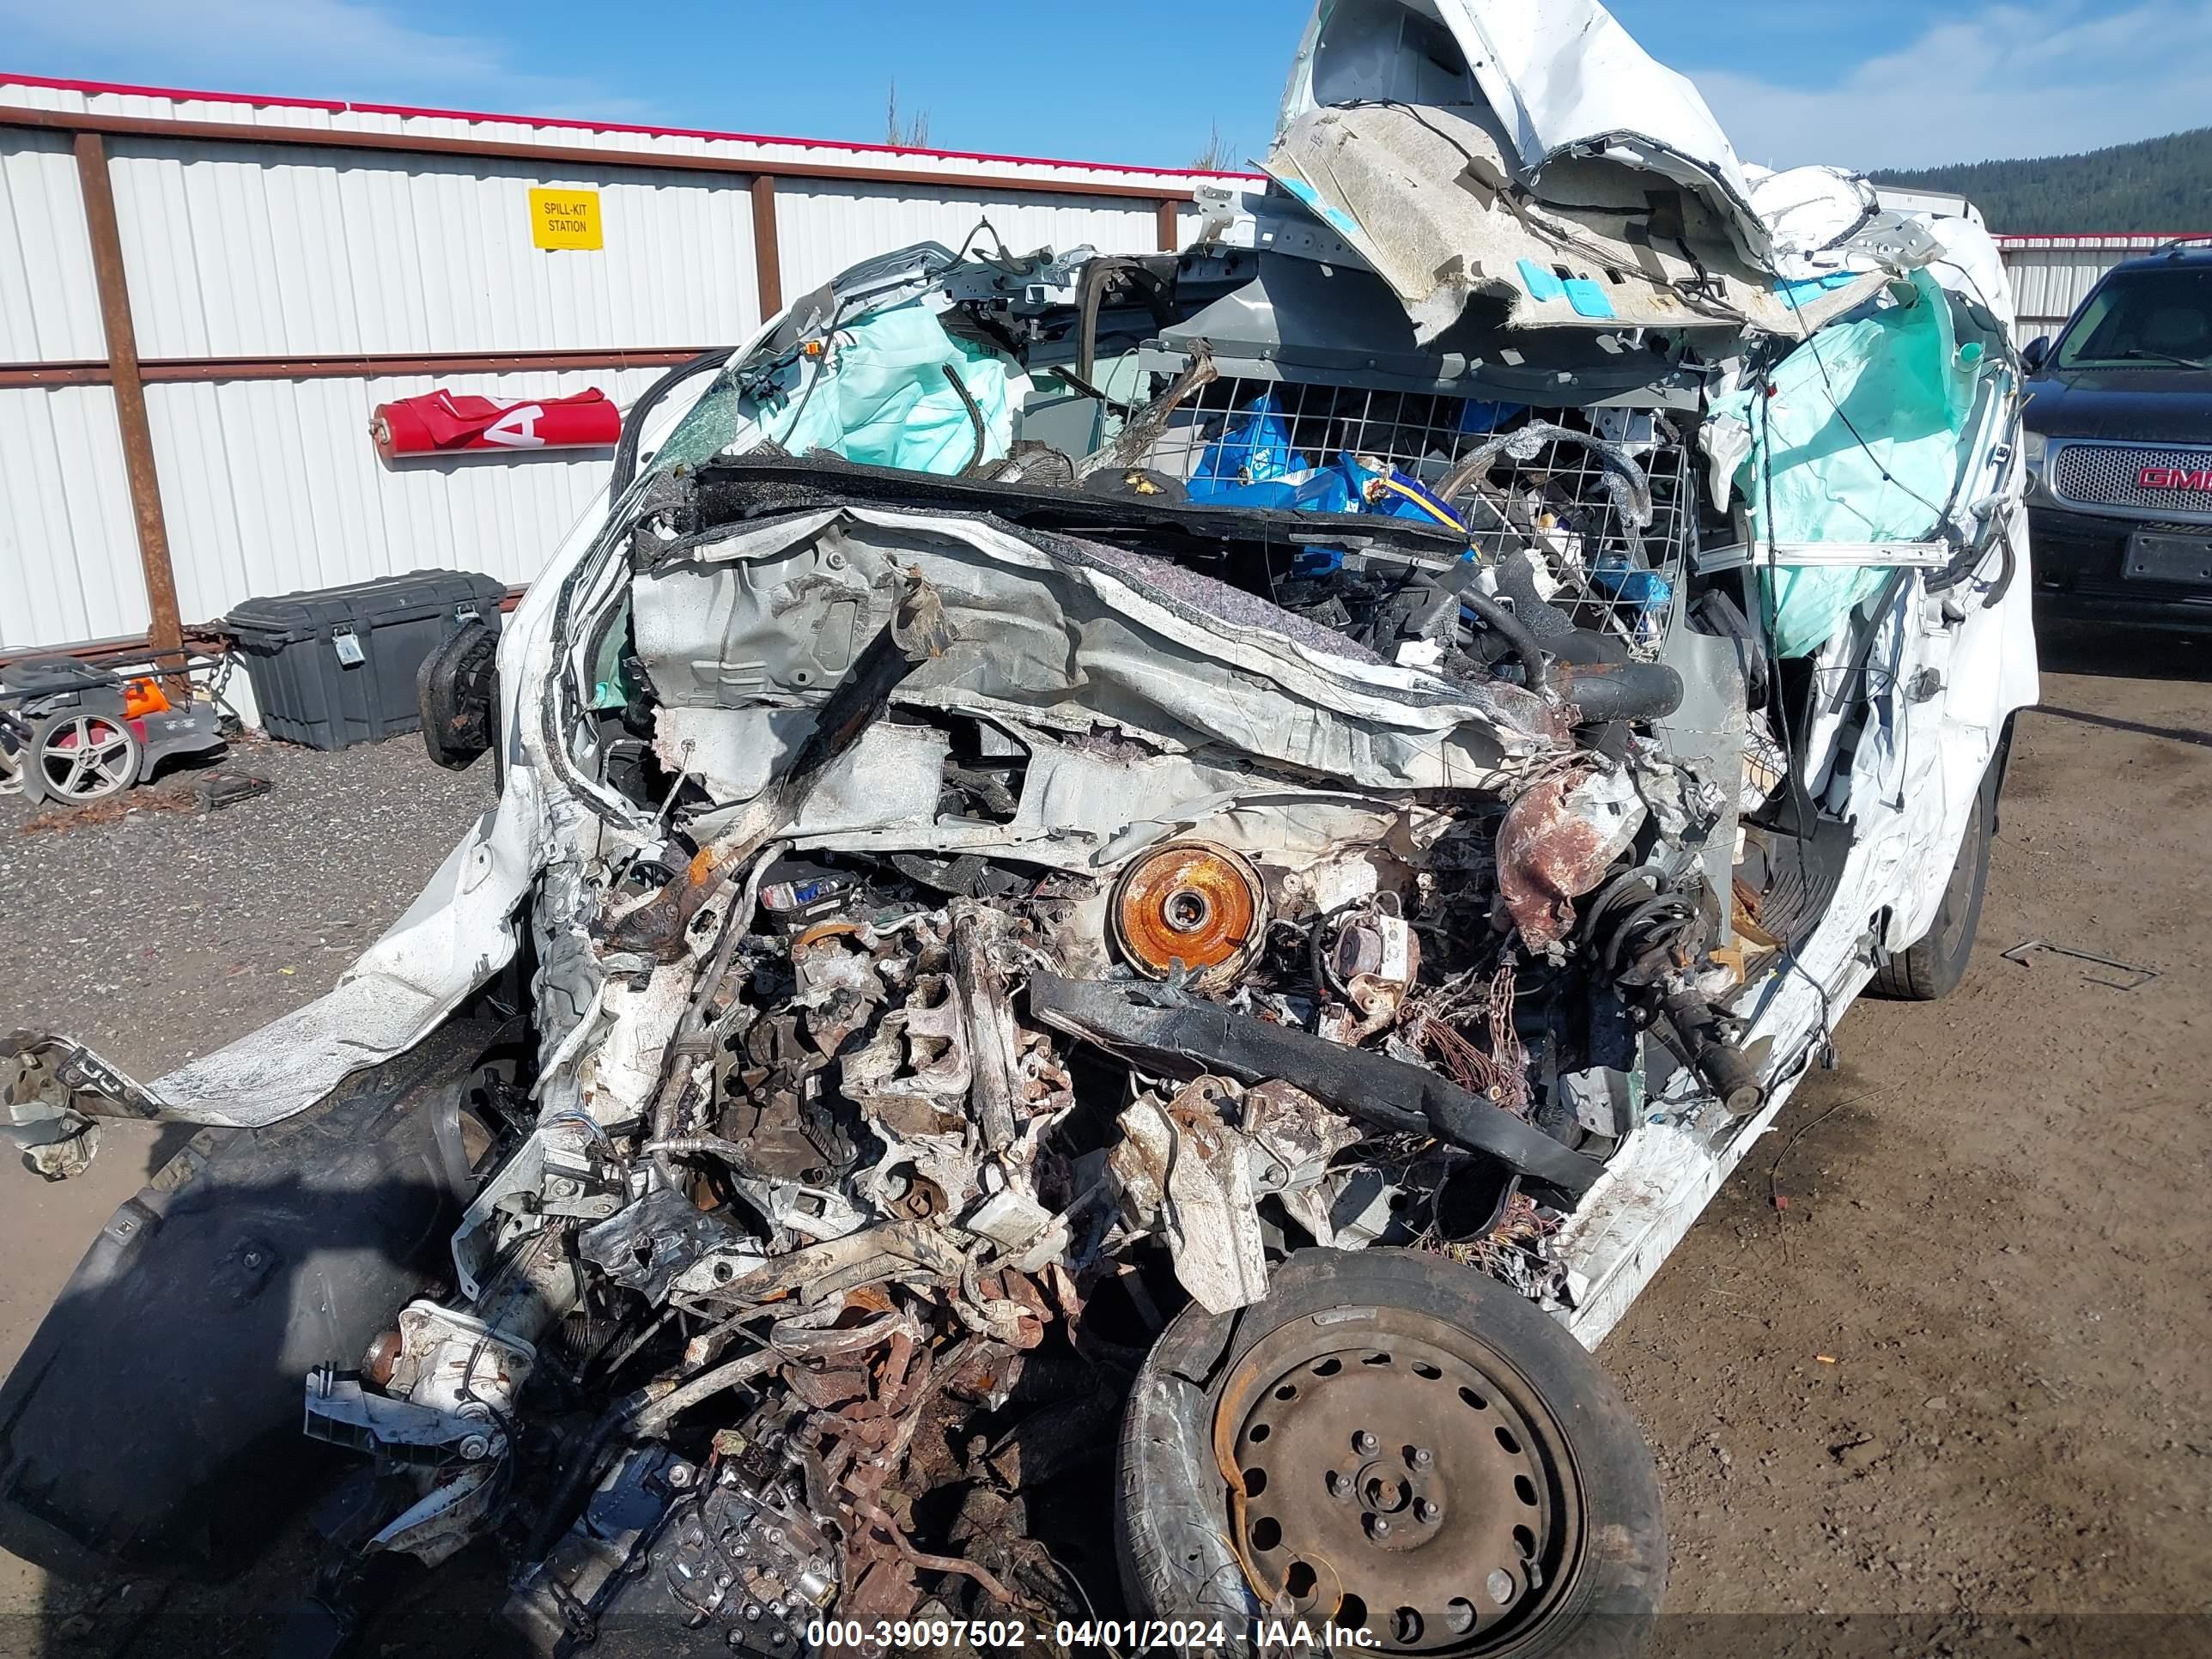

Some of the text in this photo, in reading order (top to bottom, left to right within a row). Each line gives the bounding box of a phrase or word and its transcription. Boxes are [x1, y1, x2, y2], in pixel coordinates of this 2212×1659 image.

[544, 203, 587, 216] SPILL-KIT
[548, 219, 587, 233] STATION
[2139, 467, 2212, 490] GM
